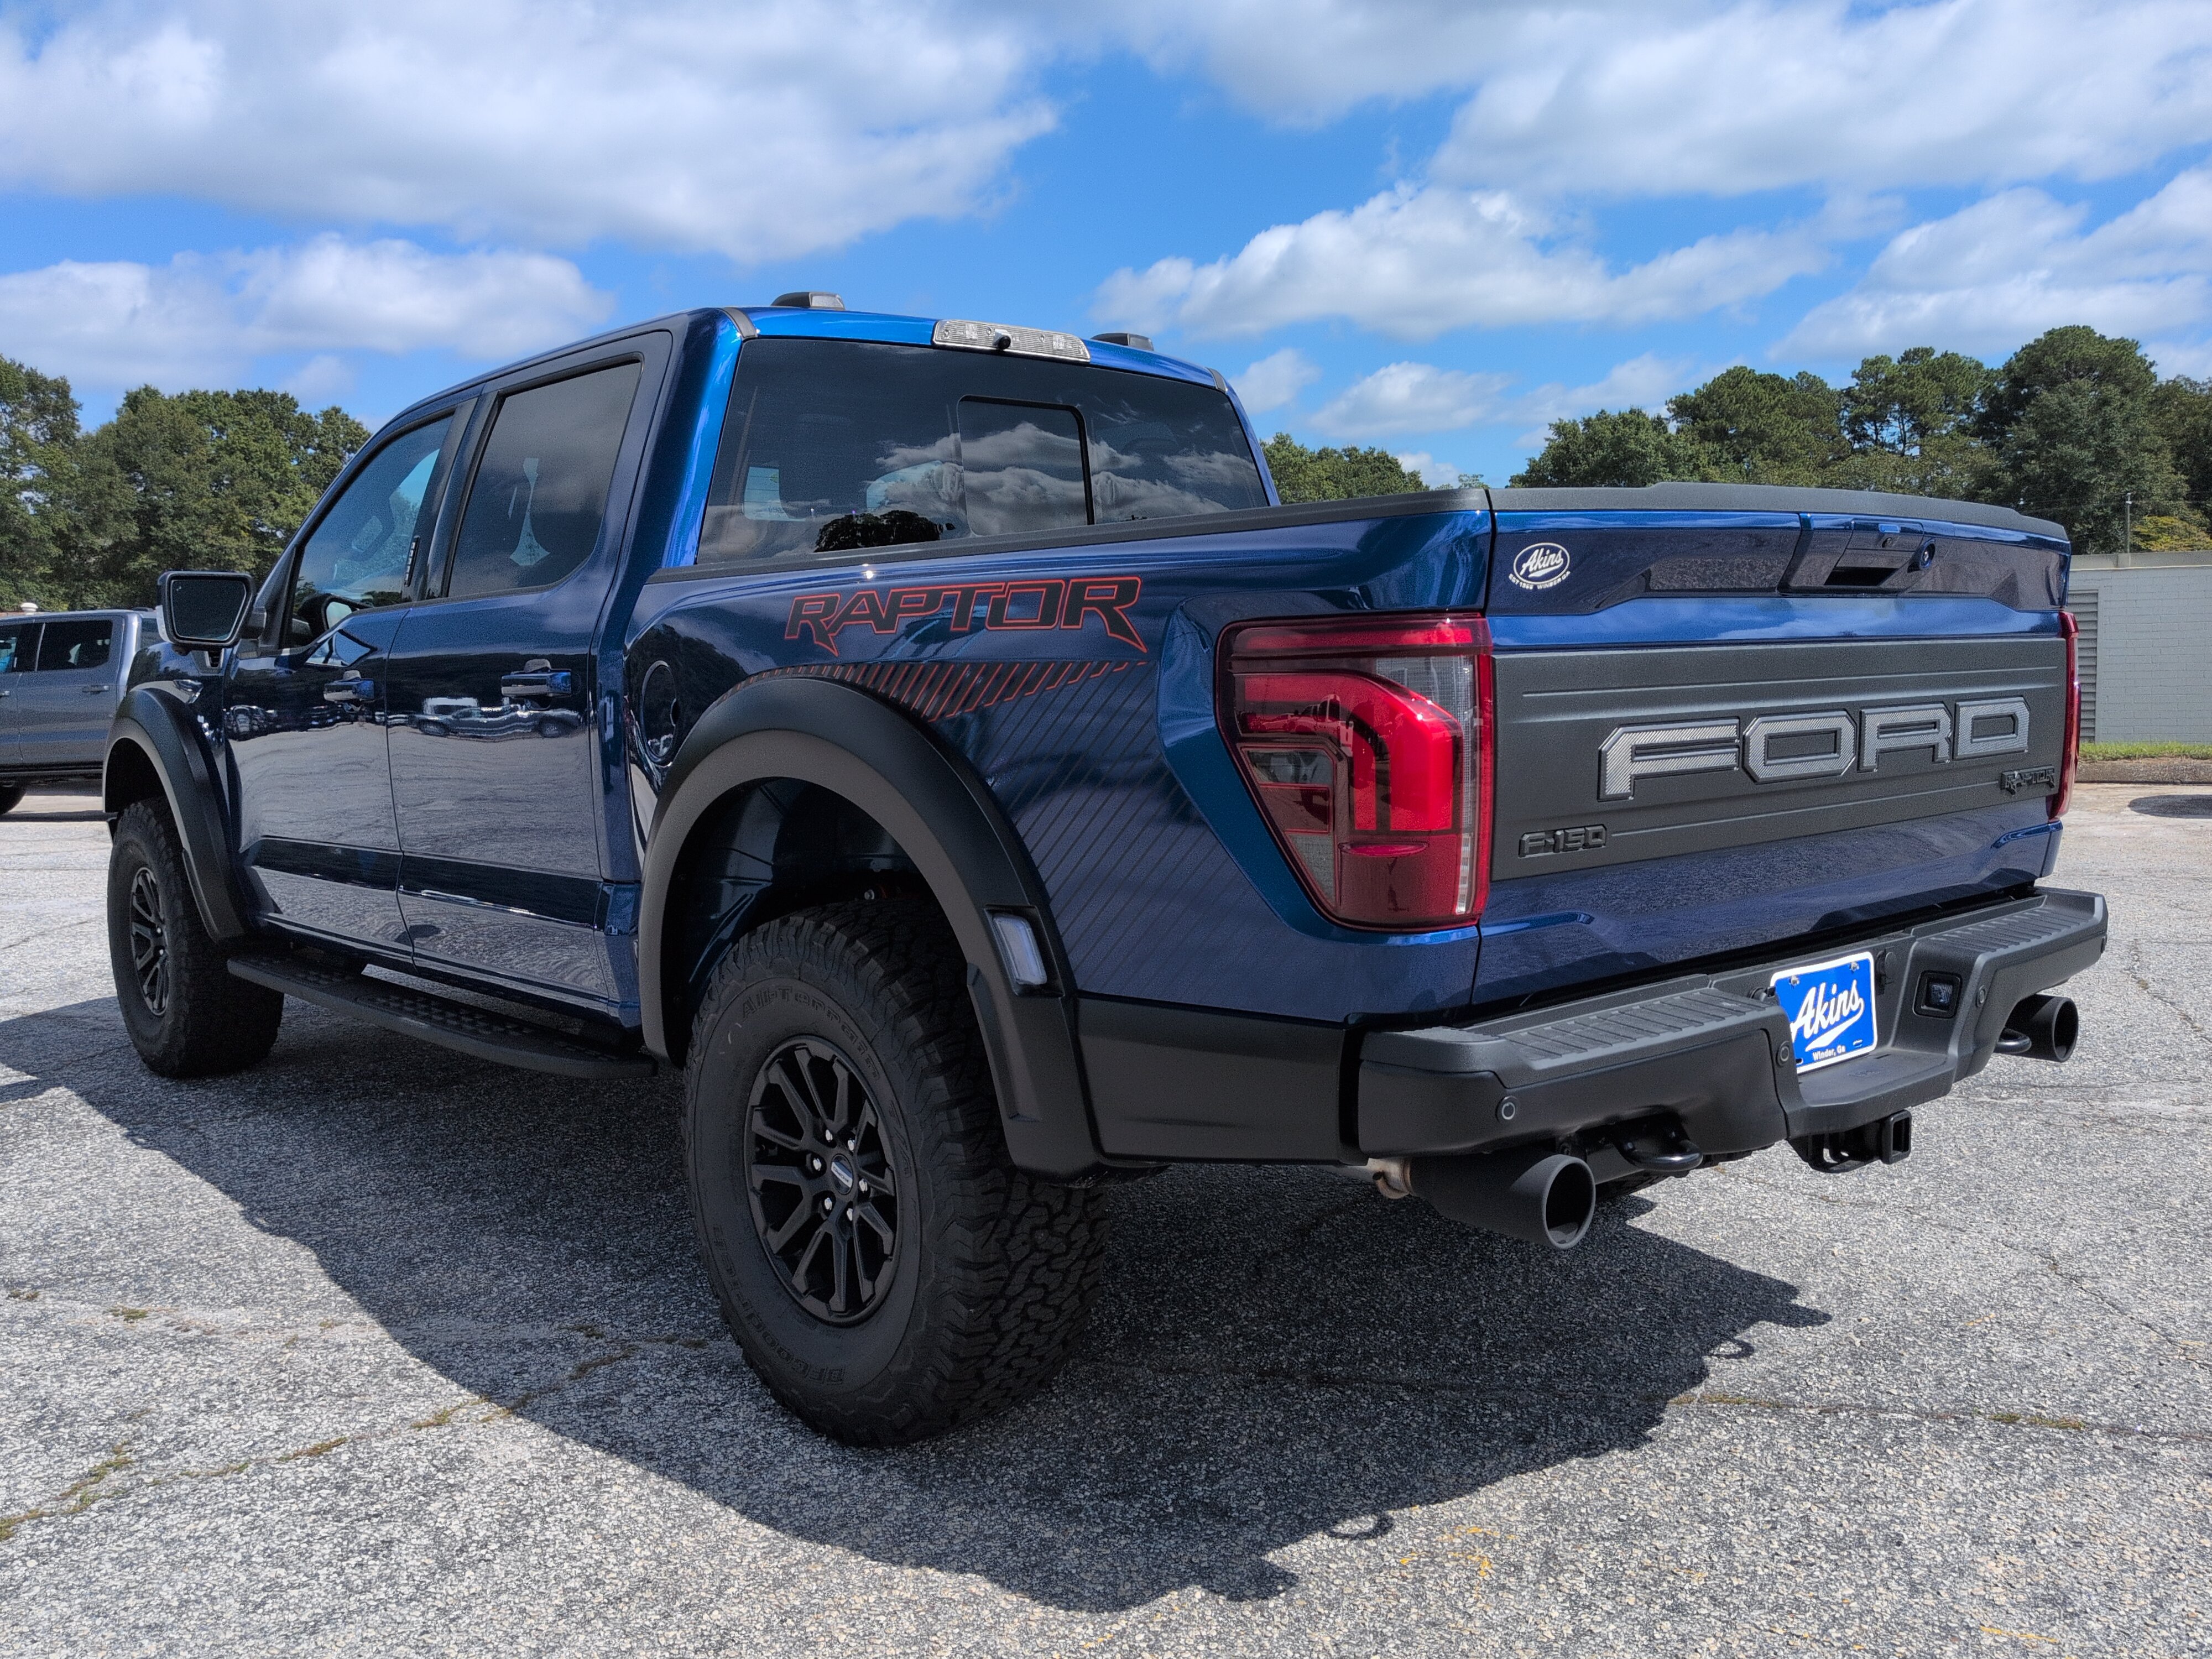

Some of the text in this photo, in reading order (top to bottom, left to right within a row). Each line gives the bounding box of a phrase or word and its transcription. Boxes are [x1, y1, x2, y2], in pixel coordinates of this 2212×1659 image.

[1519, 547, 1564, 576] Akins
[784, 576, 1148, 658] RAPTOR
[1598, 695, 2031, 802] FORD
[2000, 764, 2056, 795] RAPTOR
[1518, 823, 1607, 858] F-150
[1790, 979, 1865, 1046] Akins
